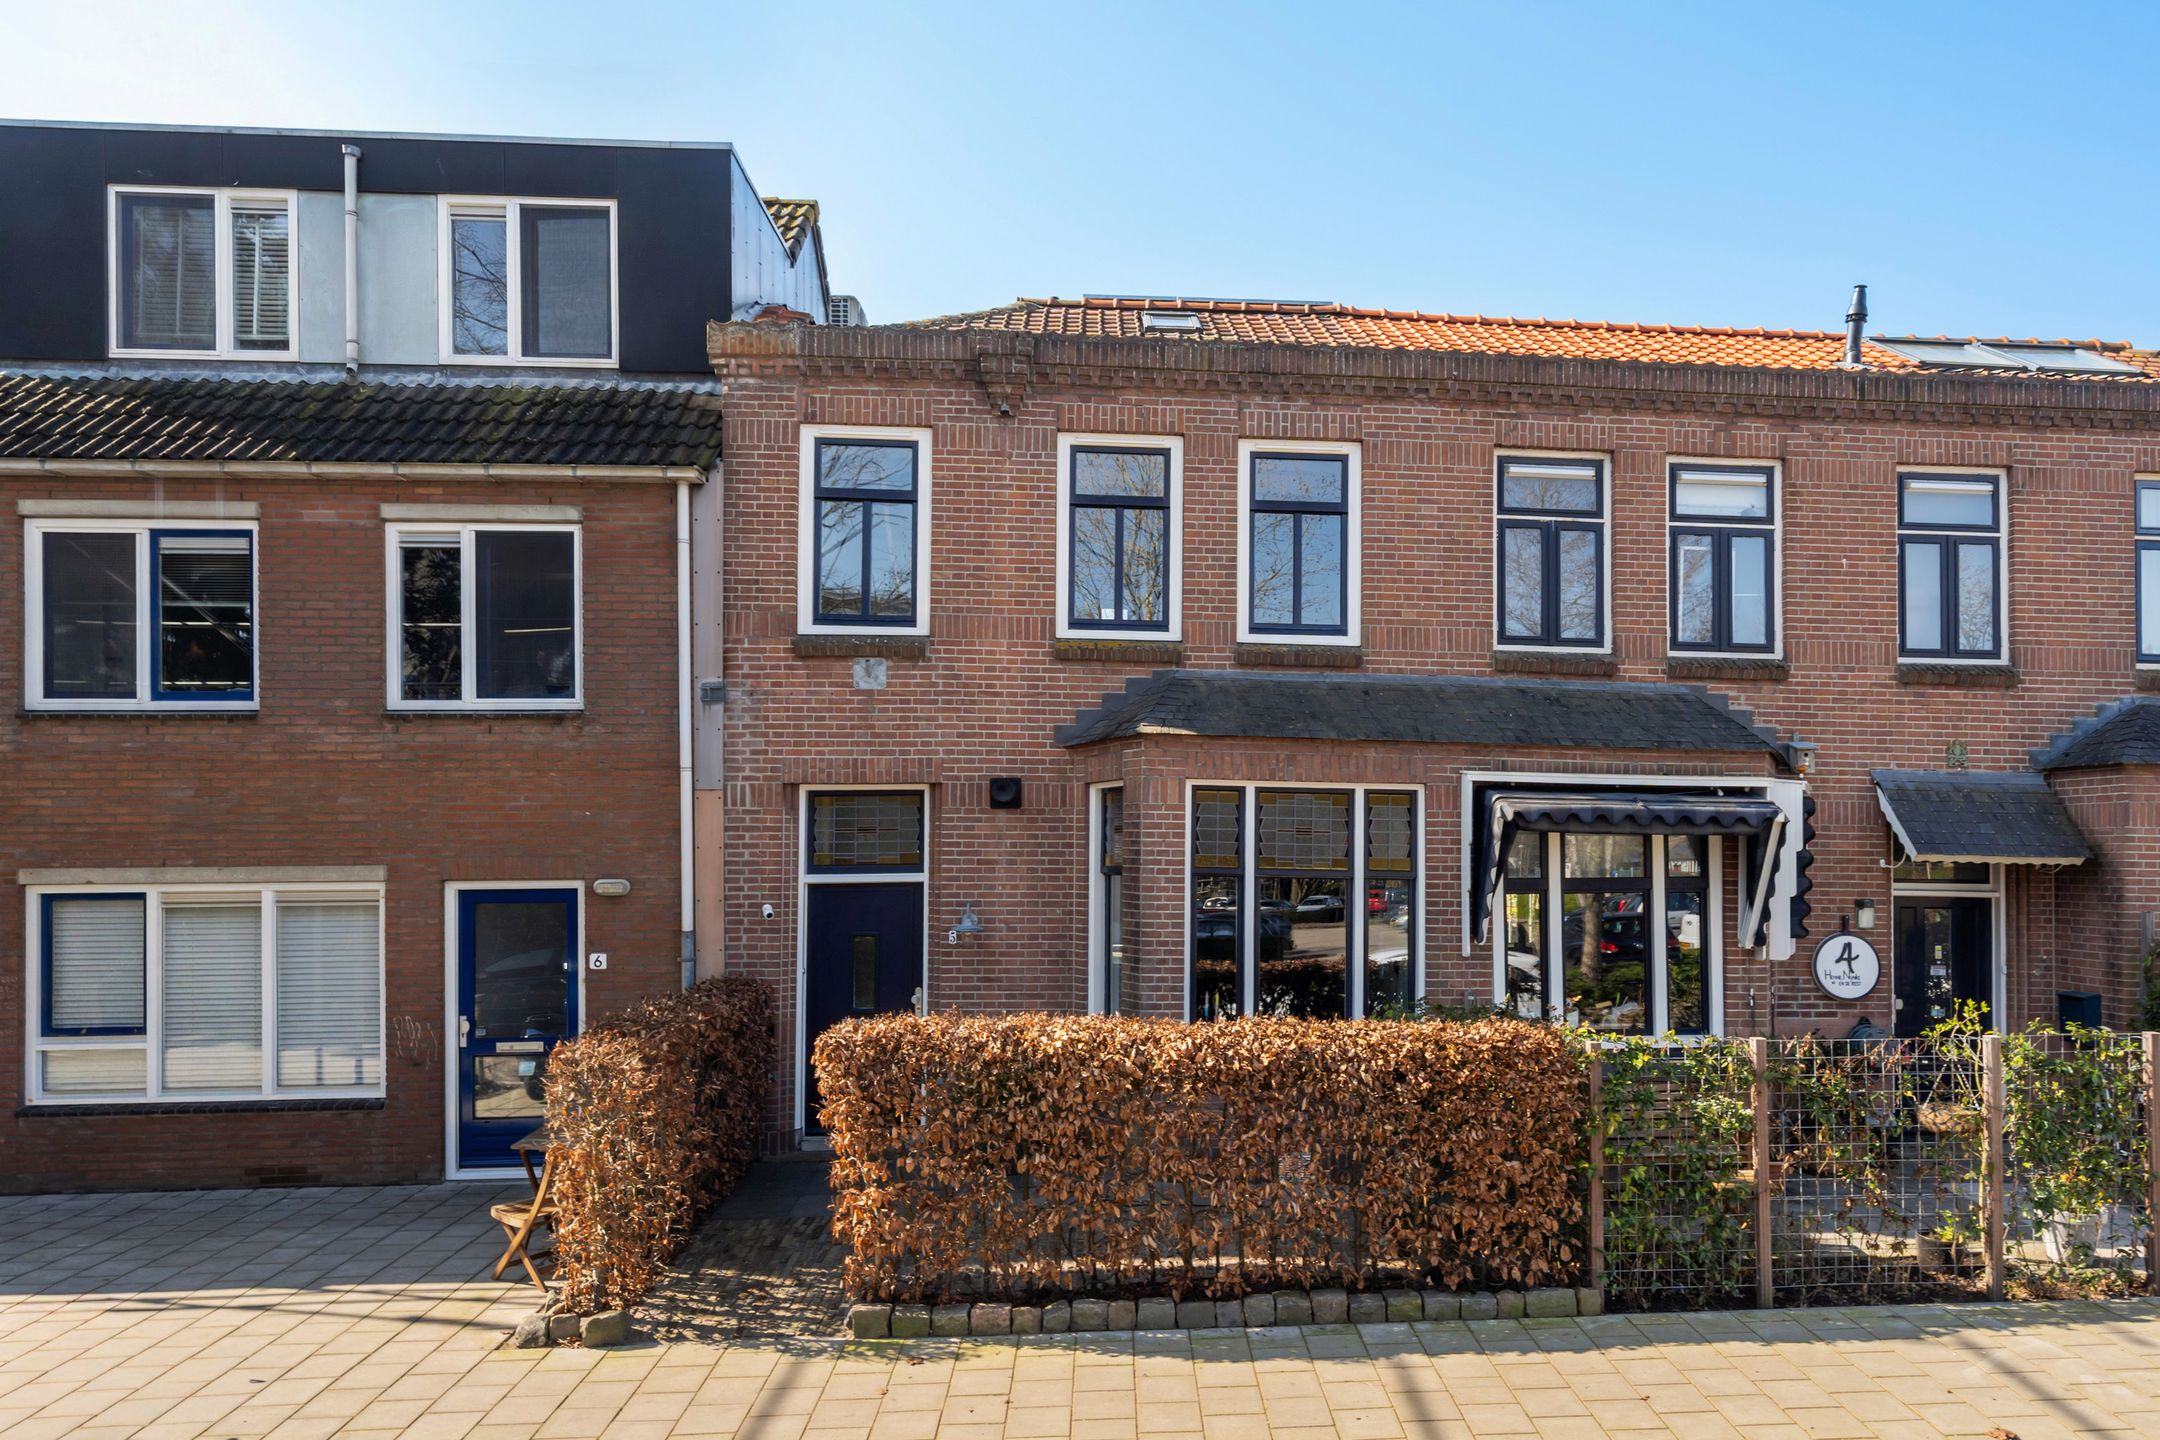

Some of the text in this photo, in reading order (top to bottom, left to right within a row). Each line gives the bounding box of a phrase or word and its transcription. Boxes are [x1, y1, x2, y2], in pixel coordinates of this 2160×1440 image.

[950, 931, 956, 943] 5
[593, 955, 602, 967] 6
[1835, 941, 1859, 973] 4
